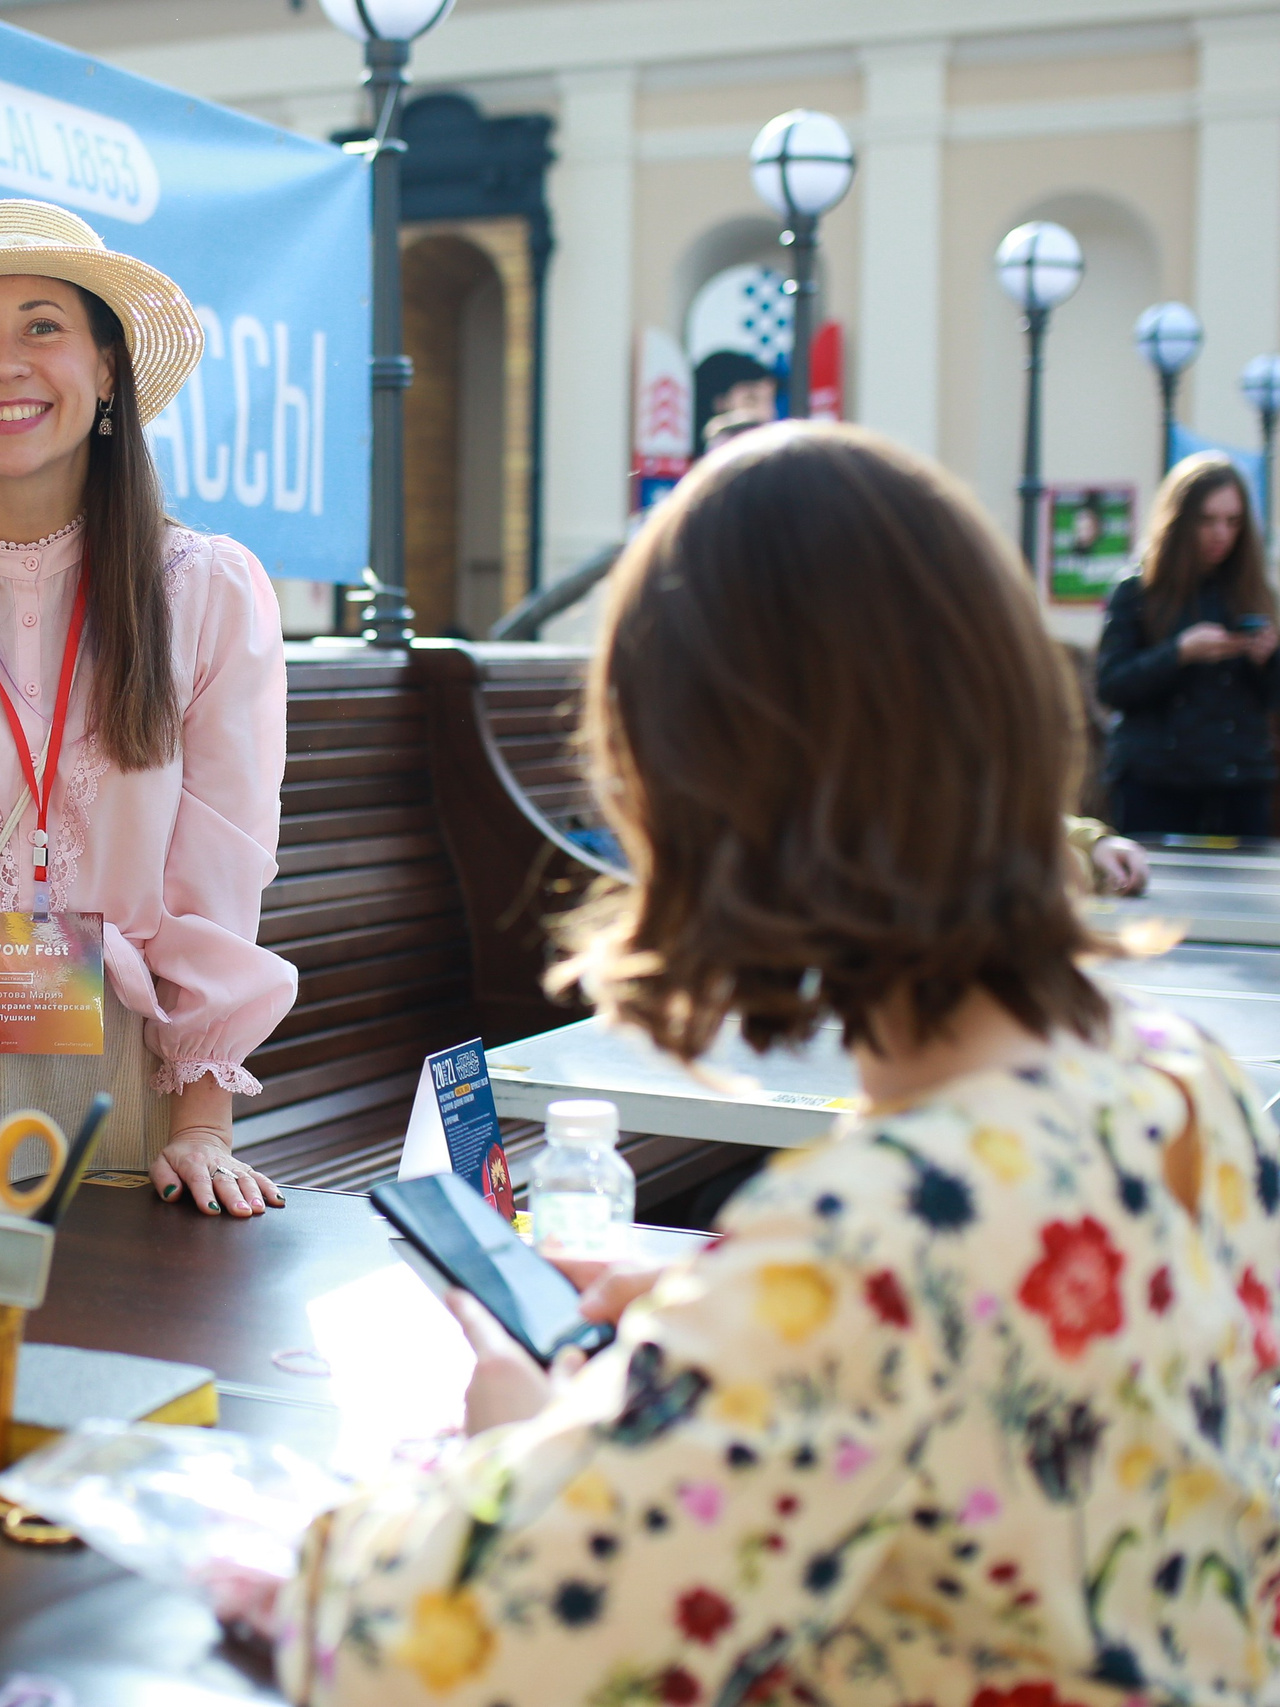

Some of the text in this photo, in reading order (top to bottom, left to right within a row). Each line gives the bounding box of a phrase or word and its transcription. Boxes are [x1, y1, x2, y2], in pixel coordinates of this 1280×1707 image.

[54, 121, 140, 207] 1853
[35, 944, 69, 956] Fest
[29, 990, 64, 1001] Мария
[456, 1049, 478, 1067] STAR
[432, 1062, 445, 1090] 20
[444, 1057, 457, 1085] 21
[455, 1060, 480, 1081] WARS
